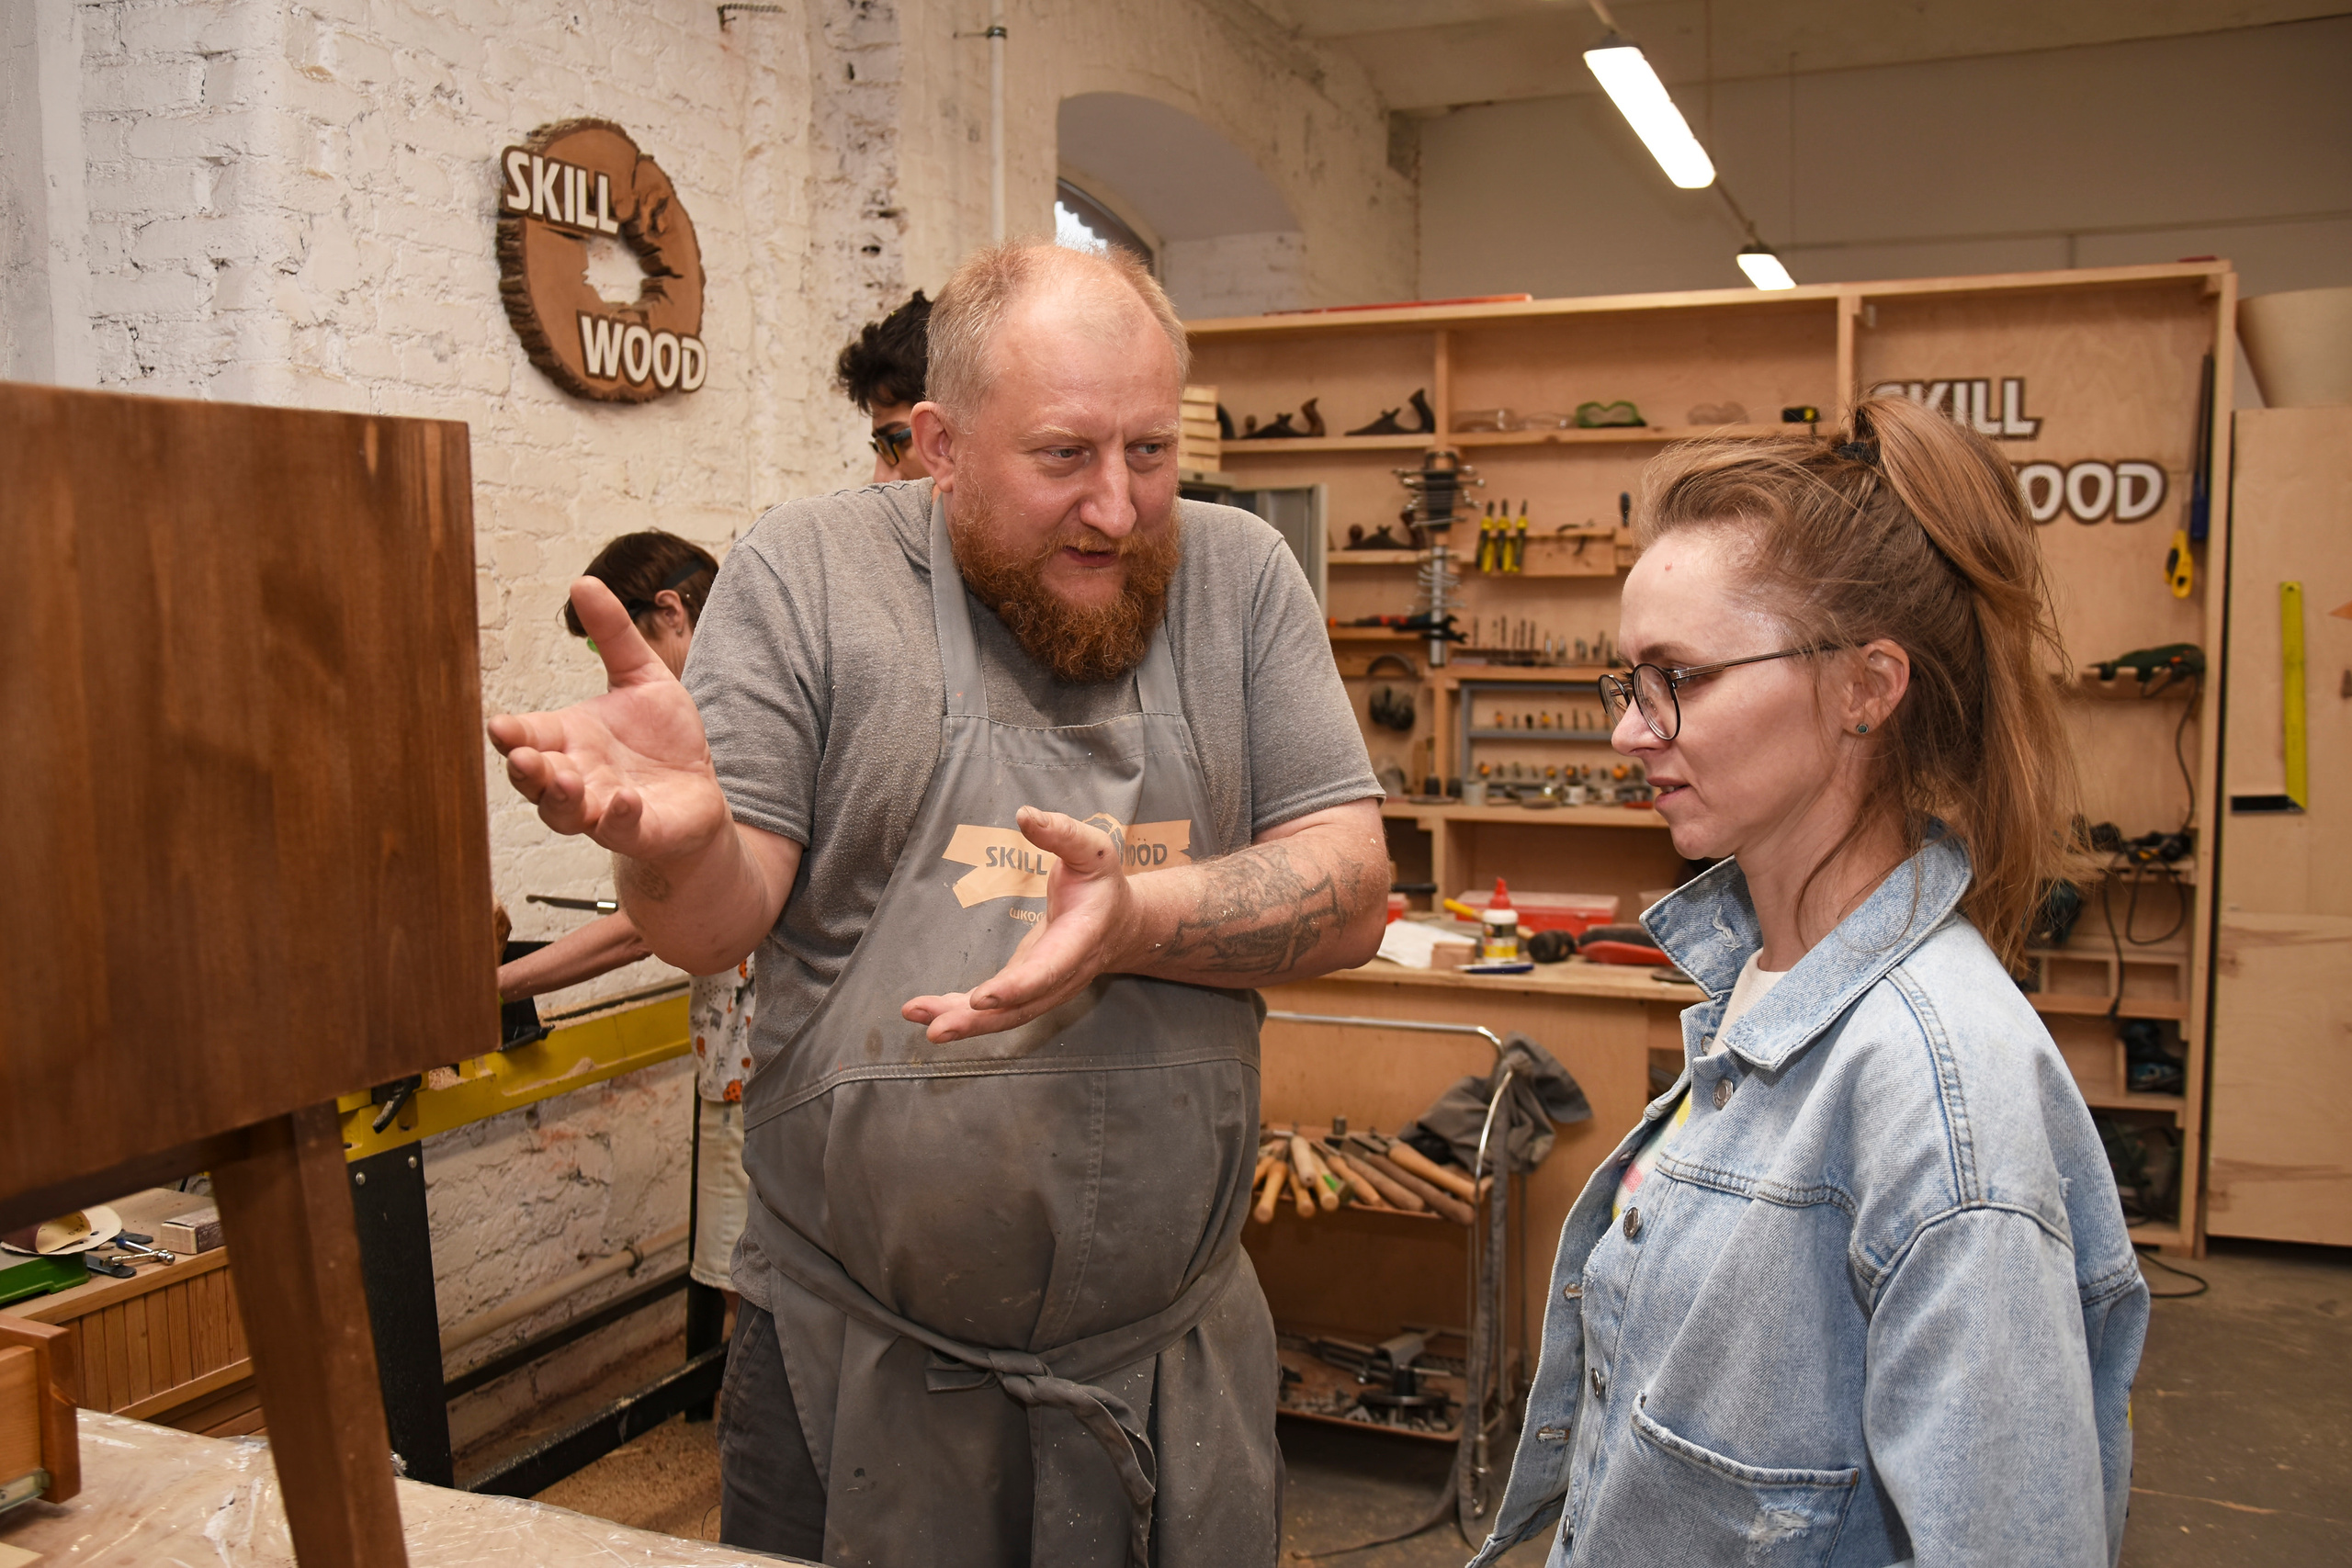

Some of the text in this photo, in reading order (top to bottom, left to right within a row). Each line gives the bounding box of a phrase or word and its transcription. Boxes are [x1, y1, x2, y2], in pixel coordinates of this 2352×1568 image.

[506, 150, 619, 234] SKILL
[581, 315, 707, 391] WOOD
[2010, 462, 2164, 522] OOD
[985, 843, 1168, 875] SKILL OOD
